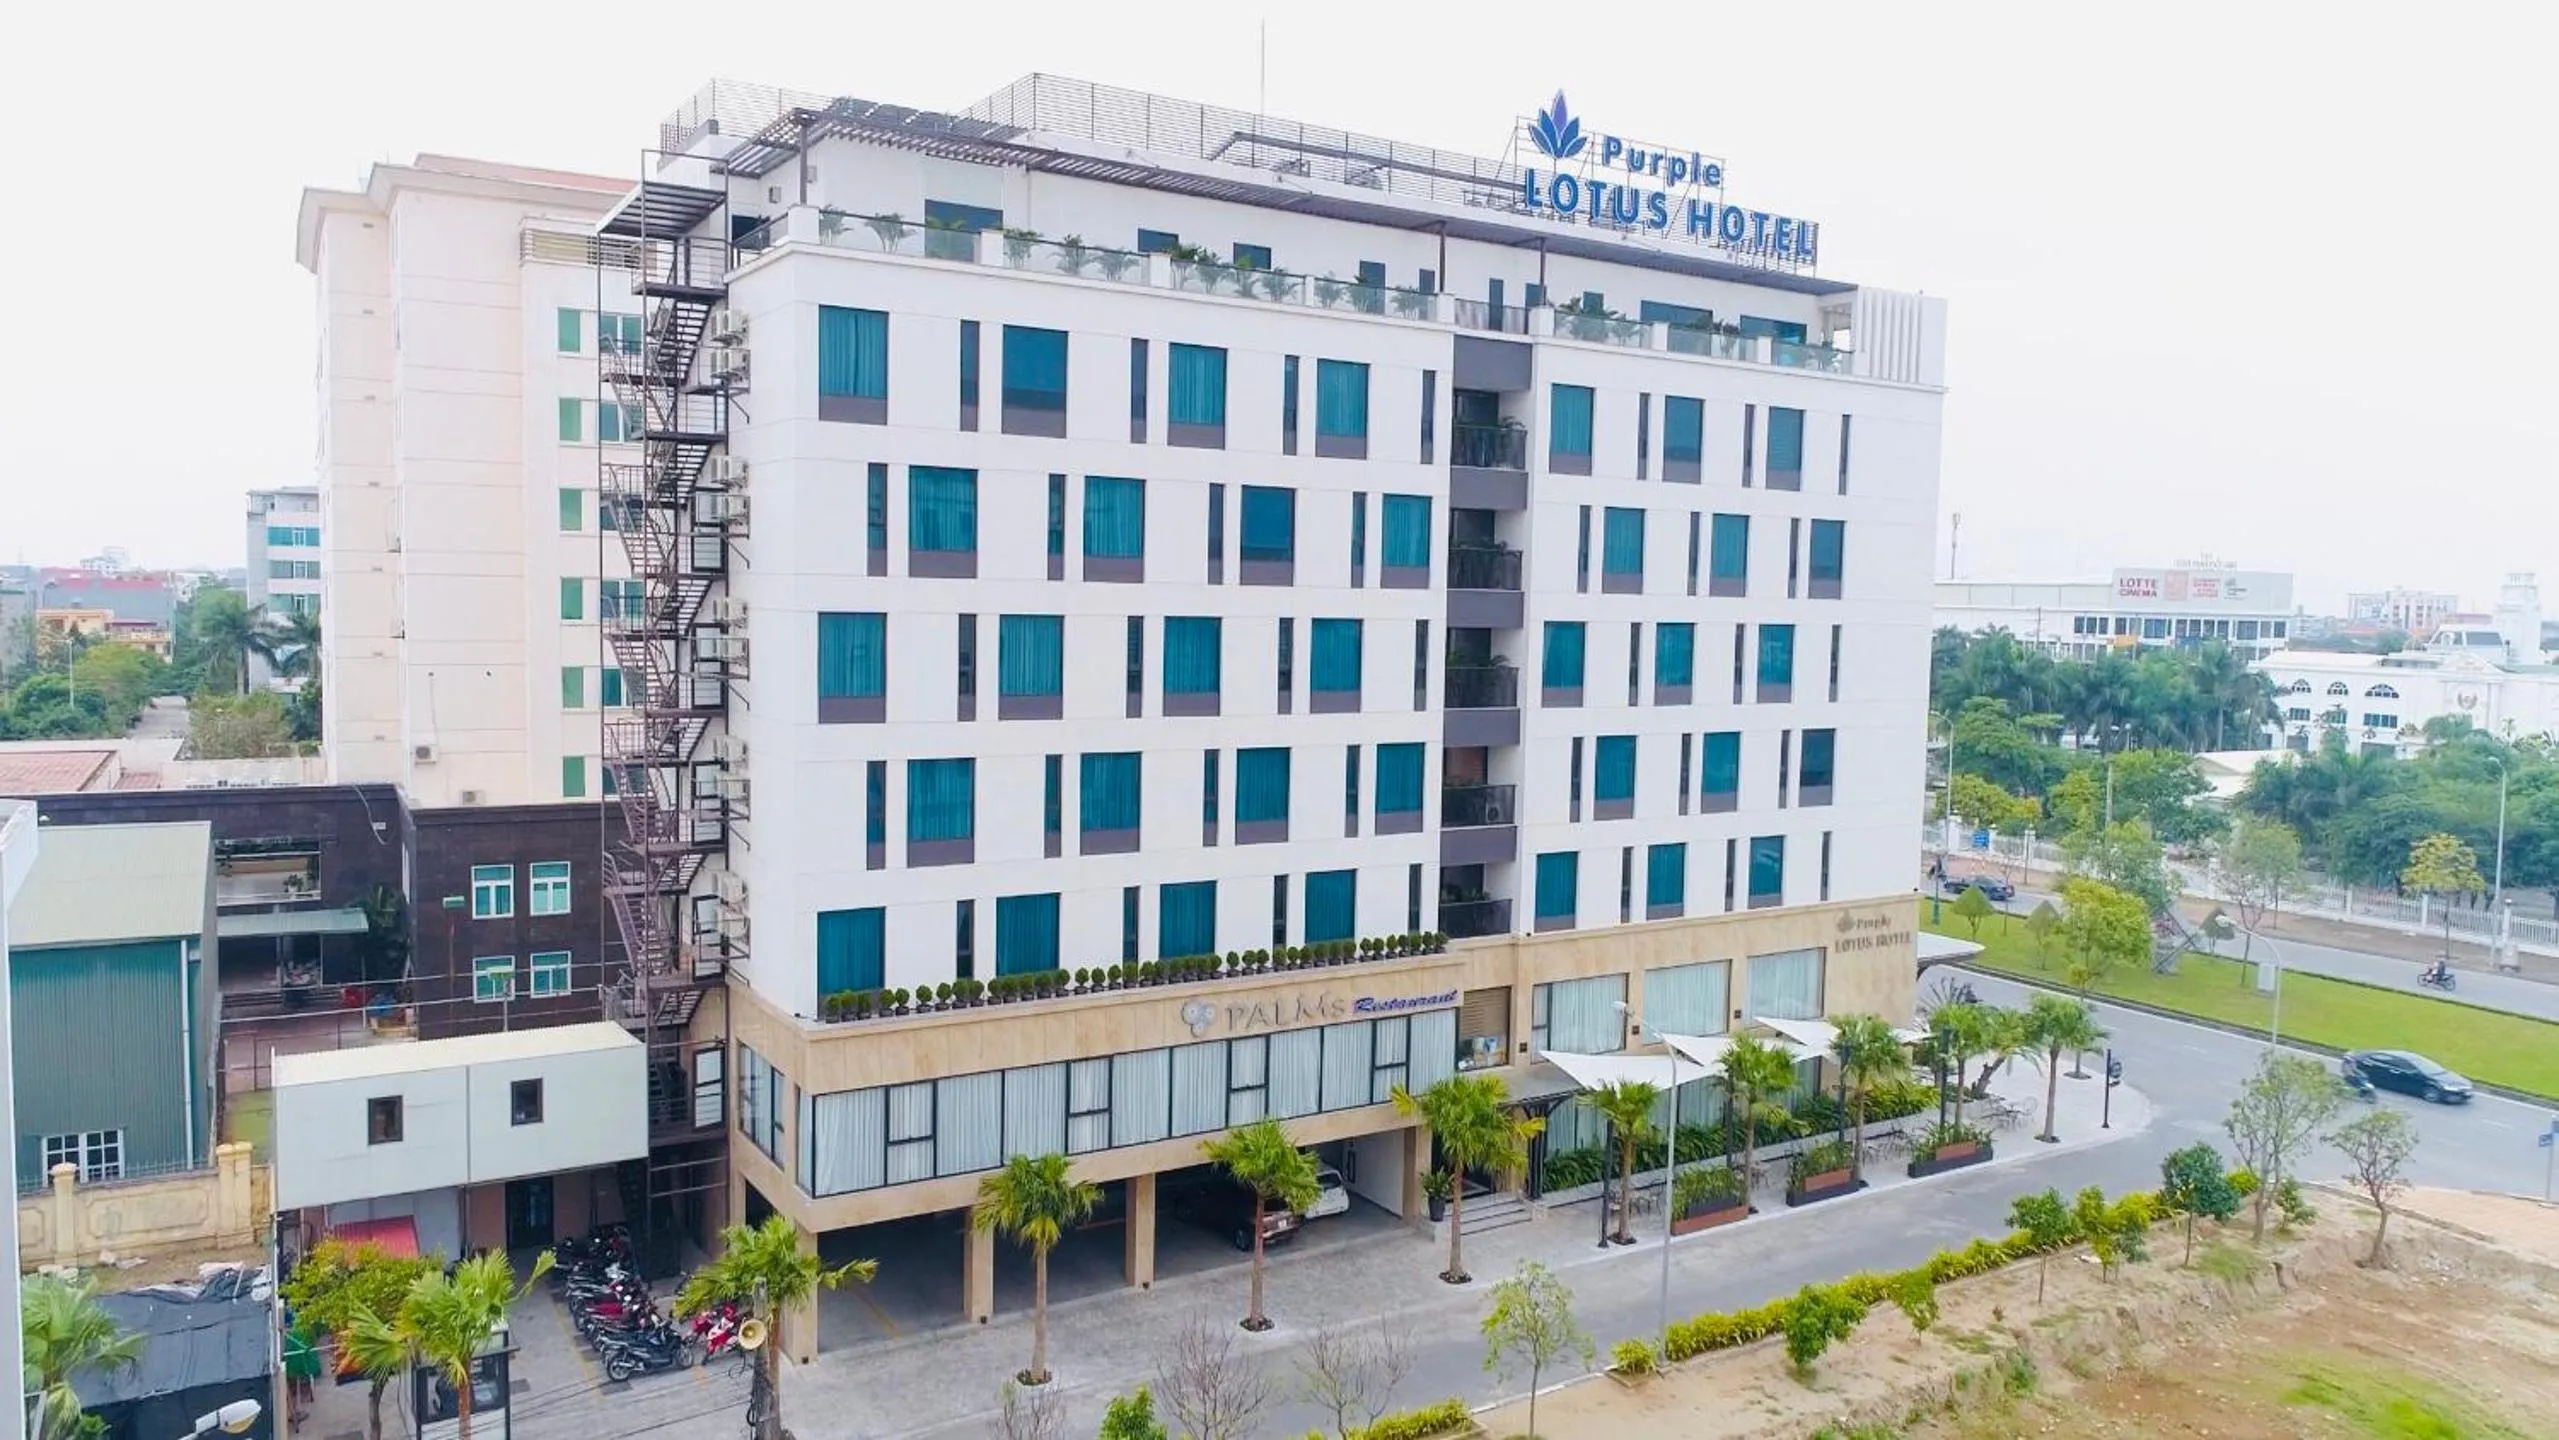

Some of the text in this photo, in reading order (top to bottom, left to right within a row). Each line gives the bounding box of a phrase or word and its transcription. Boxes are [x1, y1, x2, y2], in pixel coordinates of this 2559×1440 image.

[1602, 135, 1721, 186] Purple
[1525, 168, 1816, 257] LOTUS HOTEL
[2118, 588, 2158, 598] CINEMA
[2119, 577, 2158, 589] LOTTE
[1835, 931, 1911, 953] LOTUS HOTEL
[1353, 989, 1459, 1013] Restaurant
